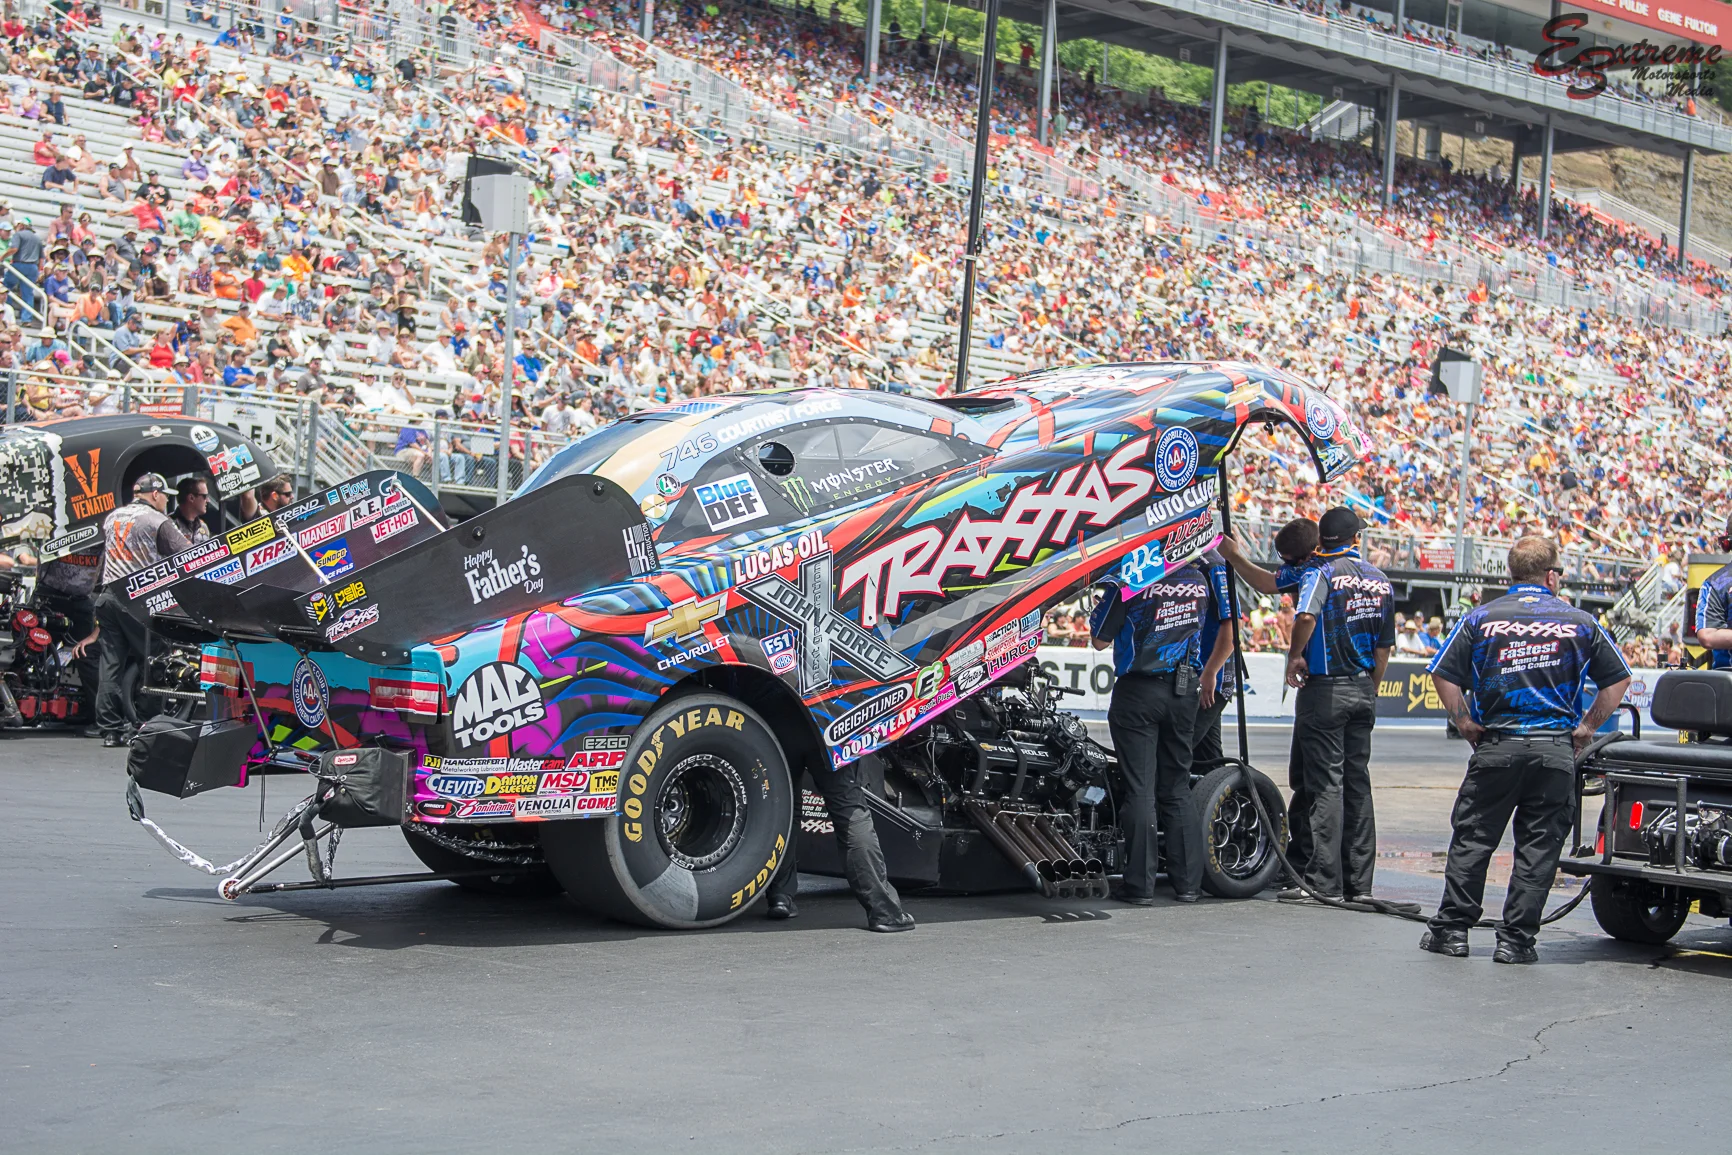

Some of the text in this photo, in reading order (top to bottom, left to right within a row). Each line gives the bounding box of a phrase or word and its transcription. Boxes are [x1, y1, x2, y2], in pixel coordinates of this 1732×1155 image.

[1657, 8, 1718, 37] GENE FULTON
[717, 399, 842, 444] COURTNEY FORCE
[660, 431, 719, 471] 746
[1157, 429, 1194, 459] AUTOMOBILE CLUB
[1157, 449, 1197, 488] SOUTHERN CALIFORNIA
[1168, 448, 1186, 467] AAA
[810, 458, 900, 494] MONSTER
[697, 479, 754, 506] Blue
[833, 476, 893, 501] ENERGY
[72, 492, 116, 519] VENATOR
[277, 499, 319, 521] TREND
[704, 494, 759, 526] DEF
[1145, 478, 1214, 527] AUTO CLUB
[229, 523, 264, 545] BME
[301, 517, 343, 549] MANLEY
[374, 509, 414, 539] JET-HOT
[838, 433, 1156, 629] TRAXXAS
[46, 528, 93, 552] FREIGHTLINER
[641, 522, 657, 569] CONSTRUCTION
[175, 541, 219, 566] LINCOLN
[188, 549, 226, 570] WELDERS
[250, 540, 286, 569] XRP
[317, 548, 348, 569] SUNOCO
[464, 549, 493, 570] Happy
[734, 529, 830, 585] LUCAS OIL
[127, 561, 177, 592] JESEL
[336, 562, 354, 576] FUELS
[465, 544, 541, 604] Father's
[524, 578, 544, 594] Day
[1142, 583, 1207, 600] TRAXXAS
[1331, 575, 1391, 595] TRAXXAS
[1155, 600, 1198, 620] Fastest
[1162, 600, 1176, 608] The
[767, 584, 892, 670] JOHN FORCE
[1155, 616, 1199, 632] Radio Control
[1164, 614, 1182, 624] Name
[1480, 620, 1578, 638] TRAXXAS
[657, 634, 731, 671] CHEVROLET
[765, 633, 791, 655] FS1
[990, 636, 1038, 673] HURCO
[1499, 640, 1559, 661] Fastest
[1509, 640, 1527, 649] The
[1501, 658, 1561, 675] Radio Control
[1512, 654, 1550, 666] Name In
[454, 663, 542, 732] MAC
[918, 690, 955, 715] Spark Plugs
[455, 701, 545, 749] TOOLS
[833, 689, 904, 740] FREIGHTLINER
[567, 750, 627, 769] ARP
[677, 753, 713, 771] WELD
[1087, 749, 1105, 761] MSD
[426, 774, 483, 795] CLEVITE
[542, 772, 588, 789] MSD
[595, 775, 618, 788] TMS
[624, 707, 746, 843] GOODYEAR
[719, 758, 747, 805] RACING
[499, 785, 536, 794] SLEEVES
[517, 798, 571, 812] VENOLIA
[577, 797, 616, 810] COMP
[730, 833, 786, 910] EAGLE
